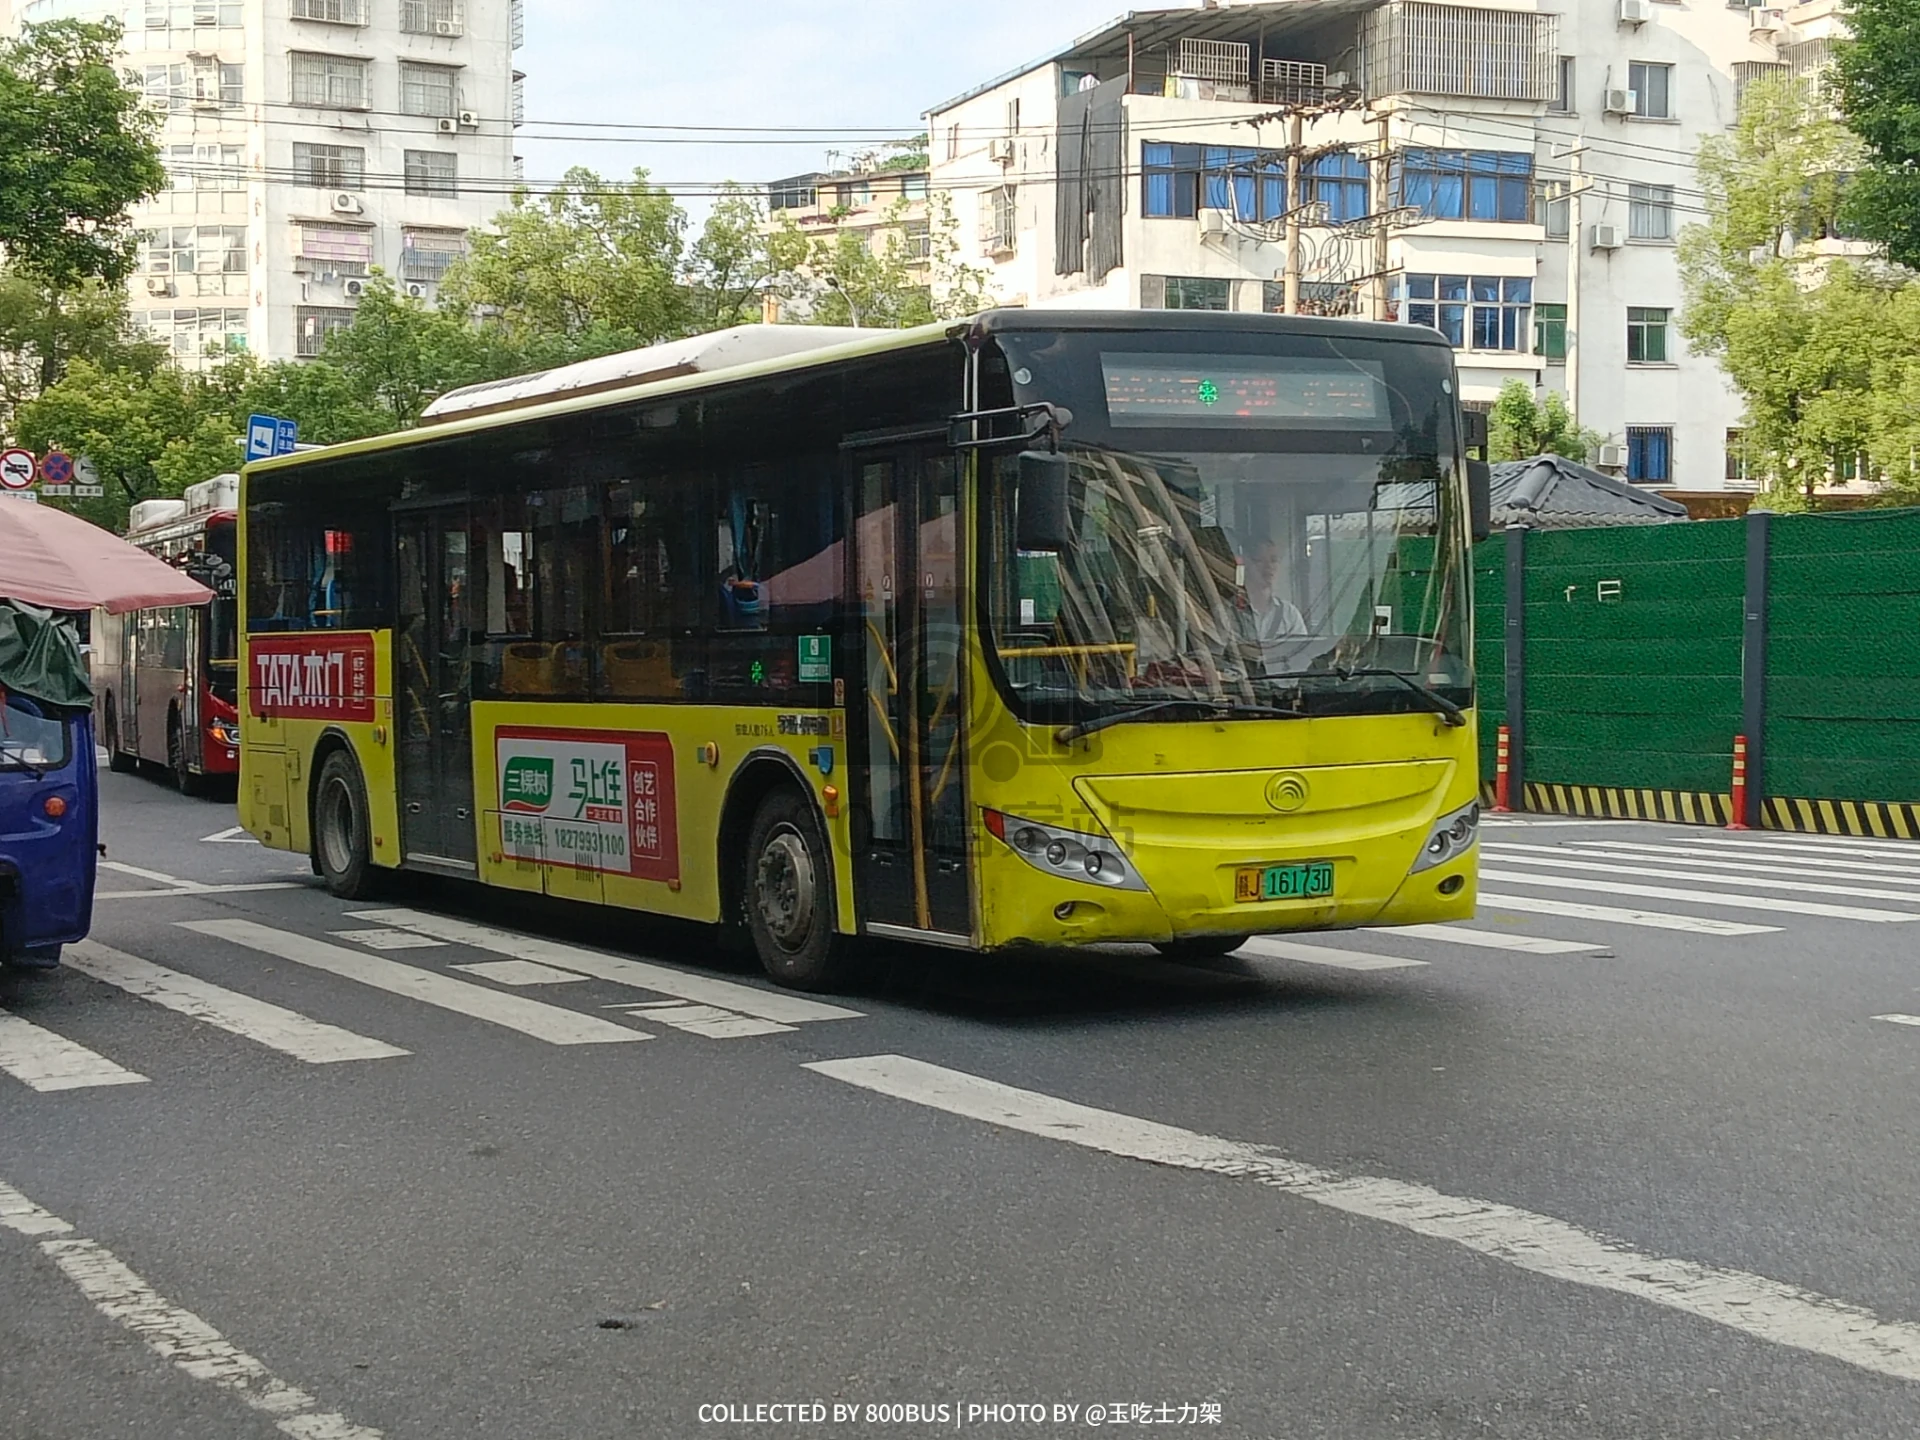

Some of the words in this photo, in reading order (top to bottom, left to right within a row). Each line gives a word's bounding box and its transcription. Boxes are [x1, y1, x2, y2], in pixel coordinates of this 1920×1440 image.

[256, 649, 345, 708] TATA木门
[507, 768, 548, 796] 三棵树
[567, 758, 623, 818] 马上住
[635, 798, 656, 823] 合作
